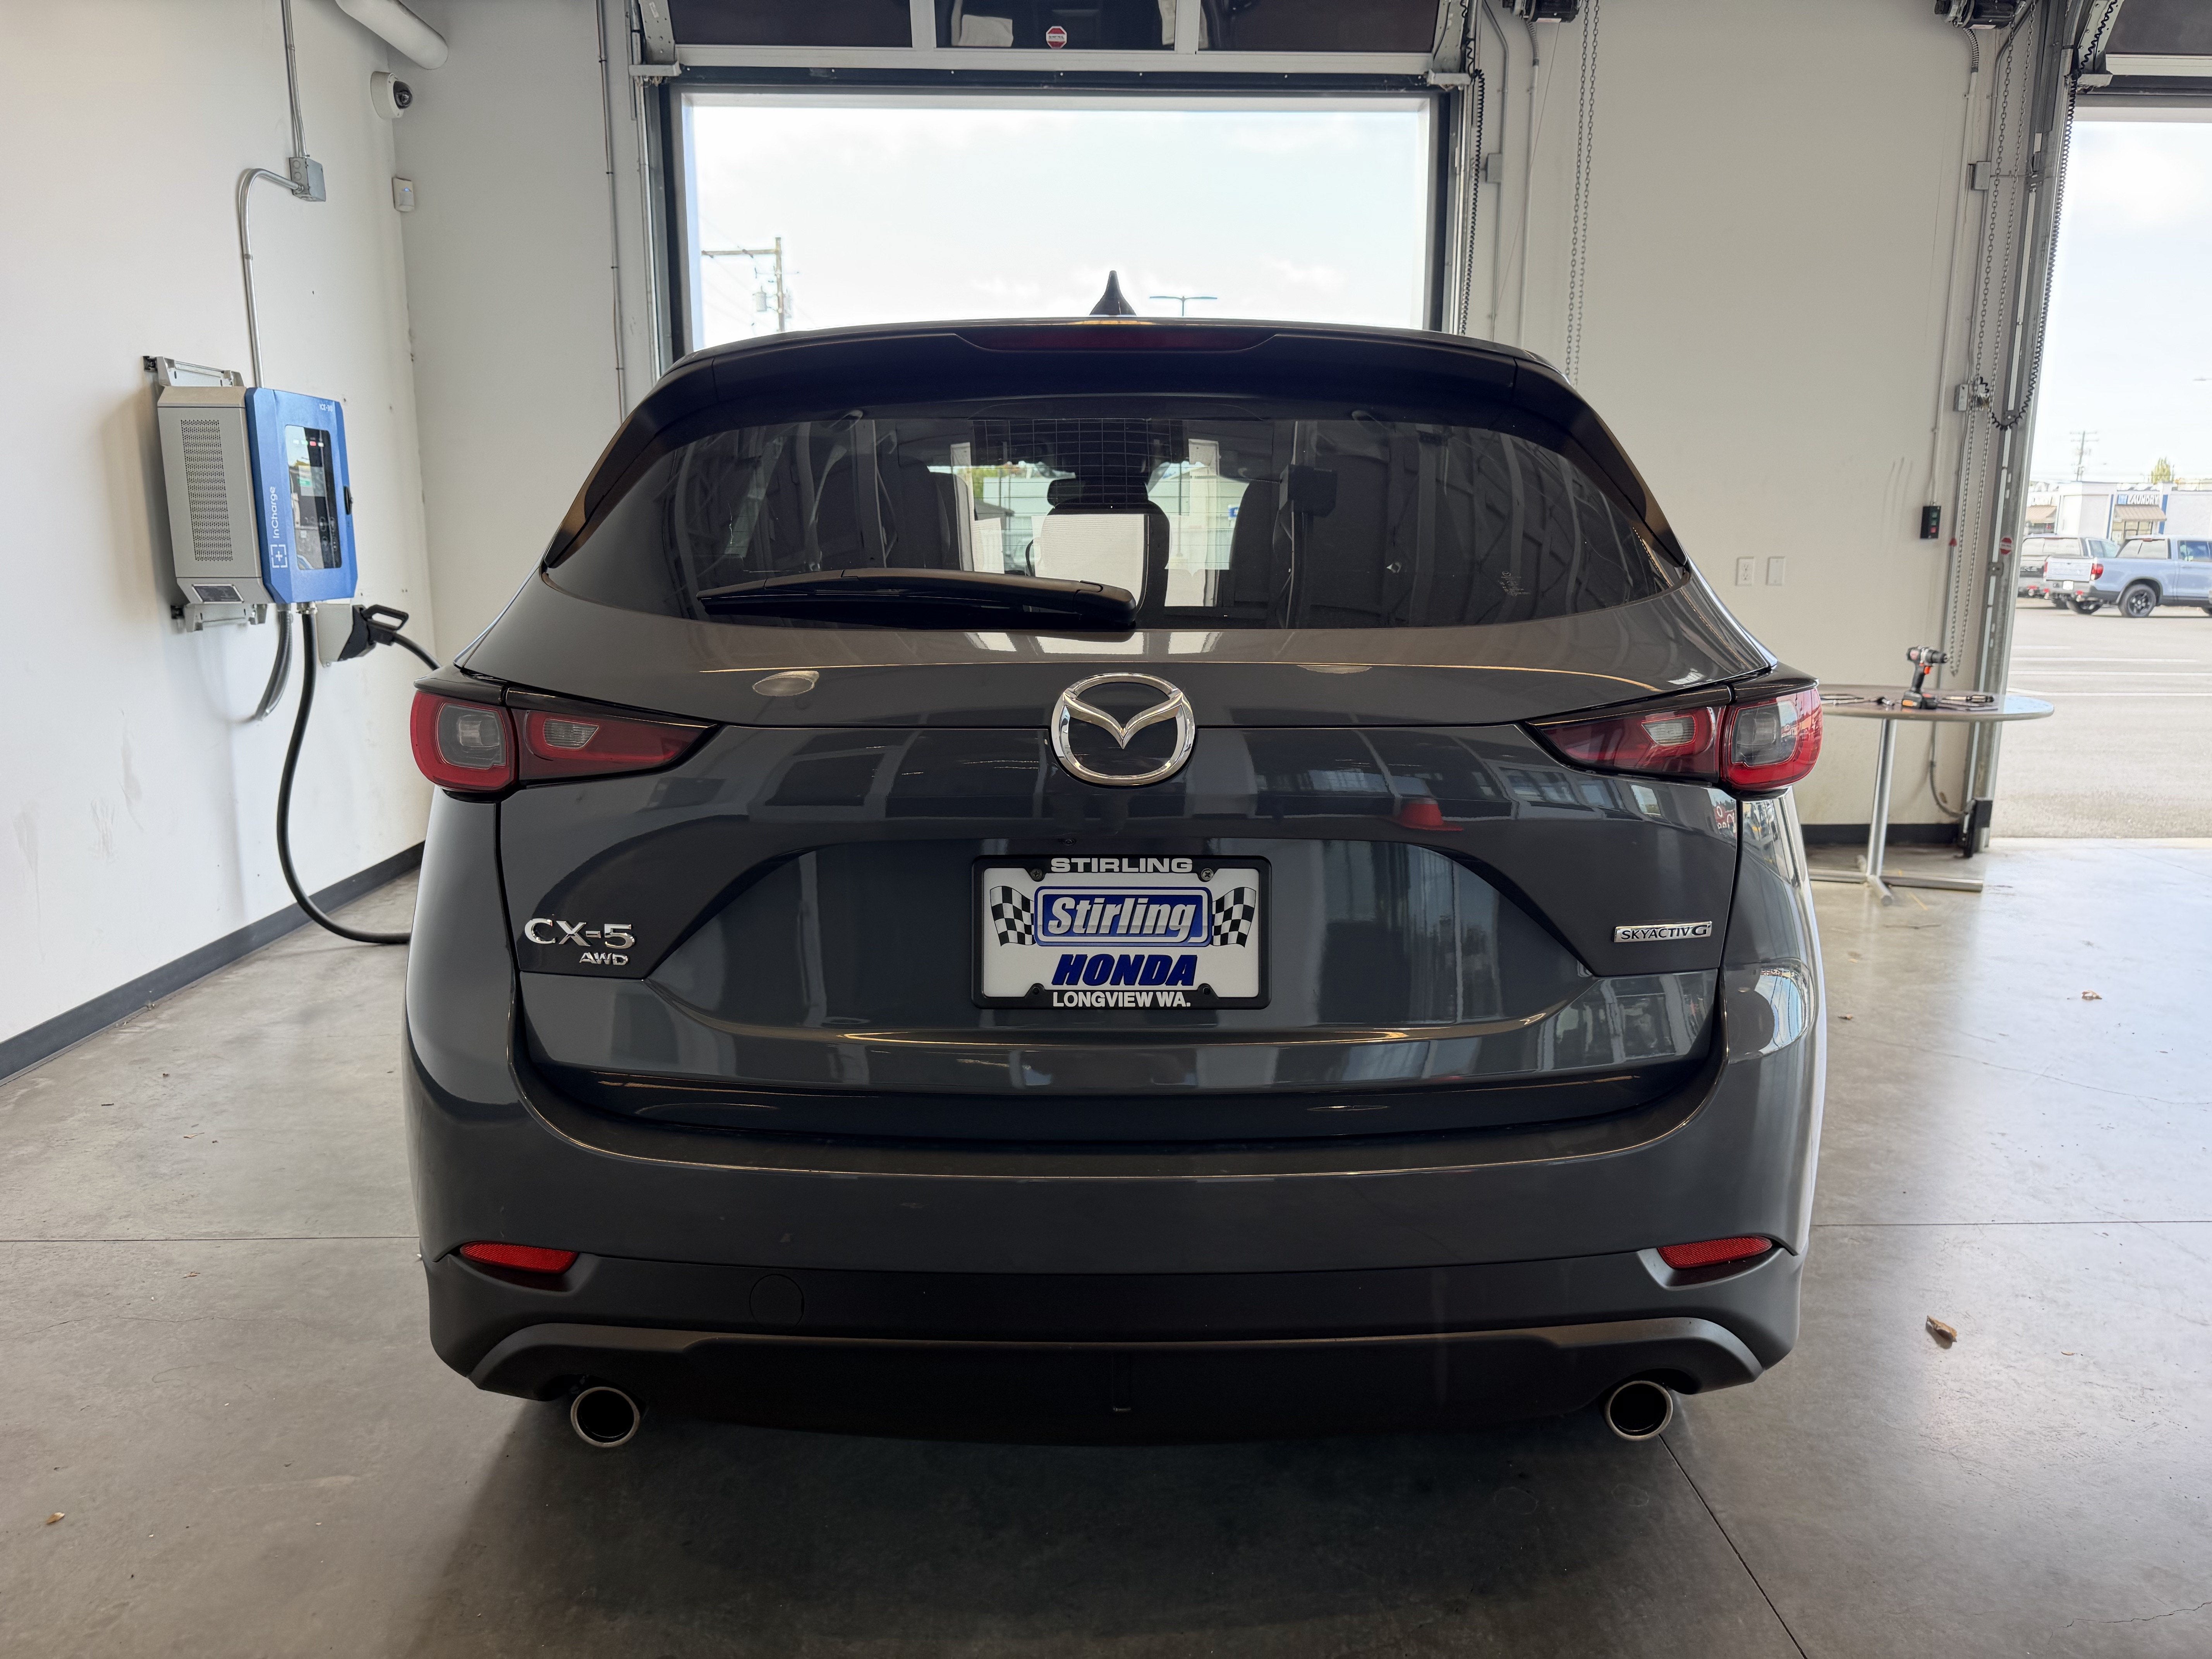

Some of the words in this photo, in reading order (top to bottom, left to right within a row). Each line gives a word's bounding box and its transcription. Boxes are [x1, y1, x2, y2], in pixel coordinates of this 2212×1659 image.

[2127, 494, 2159, 504] LAUNDRY
[270, 486, 280, 538] InCharge
[1051, 858, 1193, 872] STIRLING
[1048, 897, 1196, 943] Stirling
[525, 918, 636, 949] CX-5
[579, 951, 629, 965] AWD
[1051, 954, 1197, 986] HONDA
[1053, 992, 1154, 1007] LONGVIEW
[1156, 992, 1191, 1007] WA.
